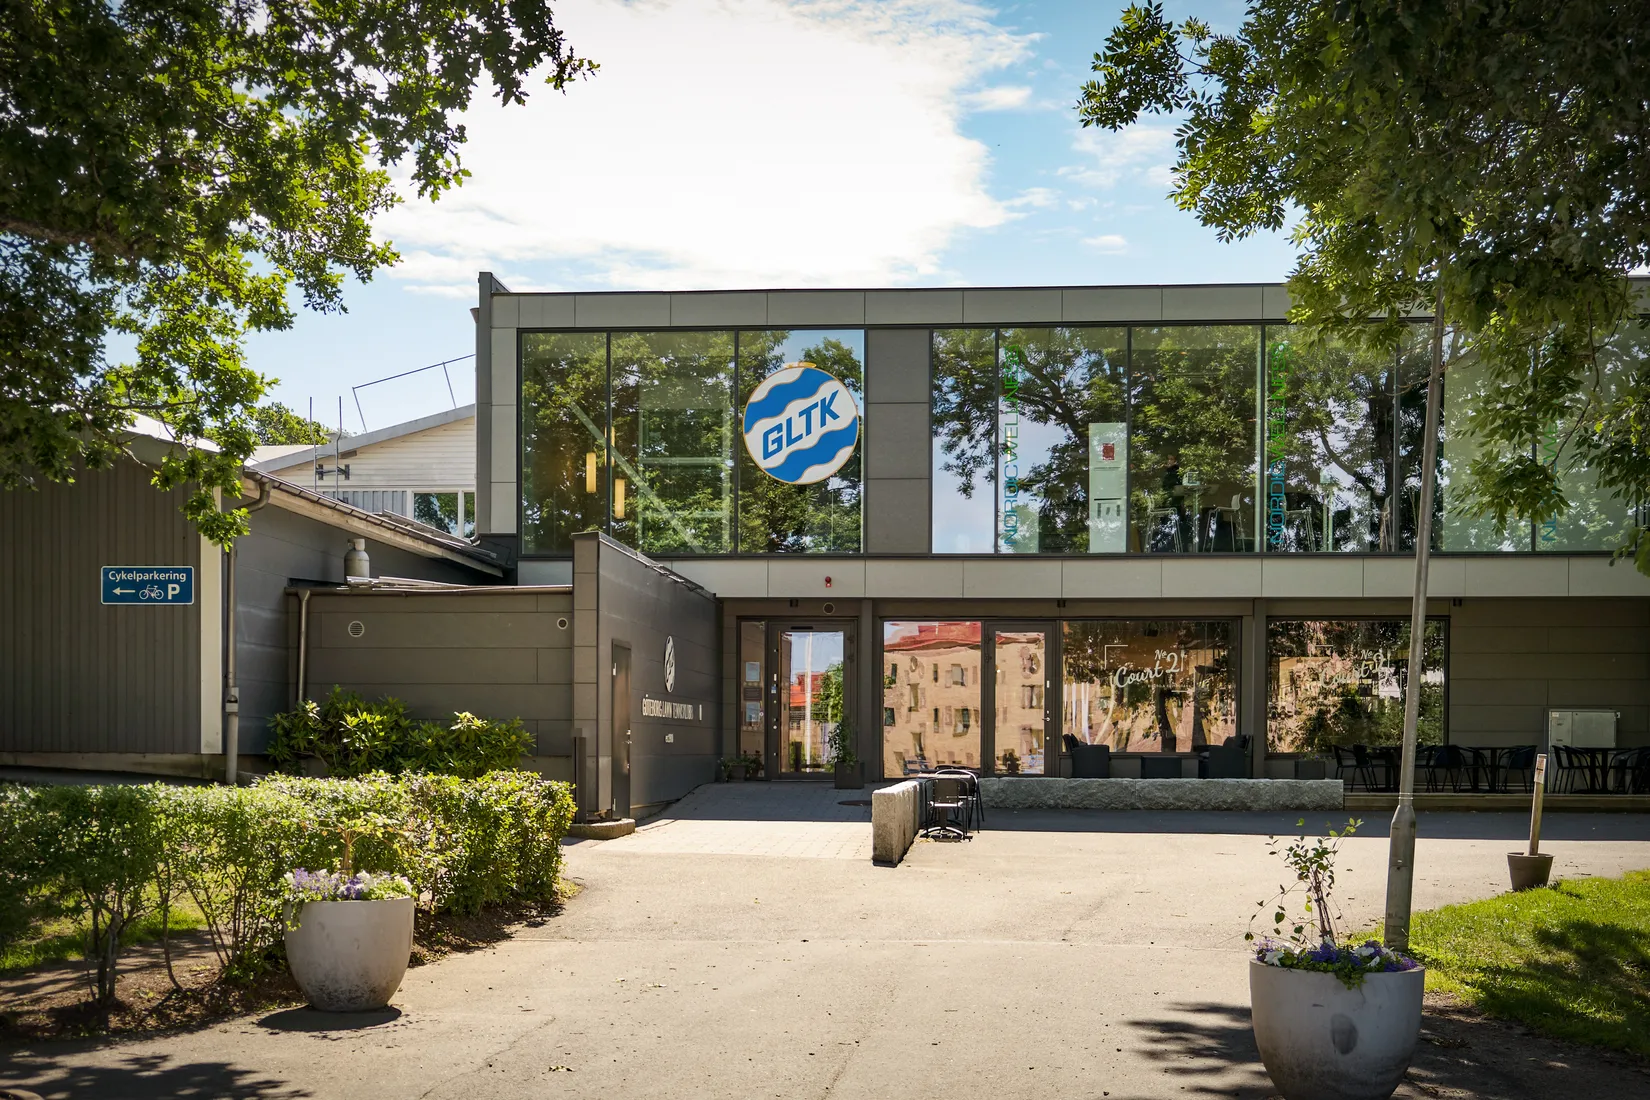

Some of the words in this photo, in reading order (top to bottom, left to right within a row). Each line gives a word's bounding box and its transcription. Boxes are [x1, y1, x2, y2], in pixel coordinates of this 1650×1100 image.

[762, 389, 840, 461] GLTK
[108, 570, 187, 582] Cykelparkering
[167, 583, 180, 600] P
[1115, 660, 1164, 689] Court
[1165, 652, 1180, 674] 2
